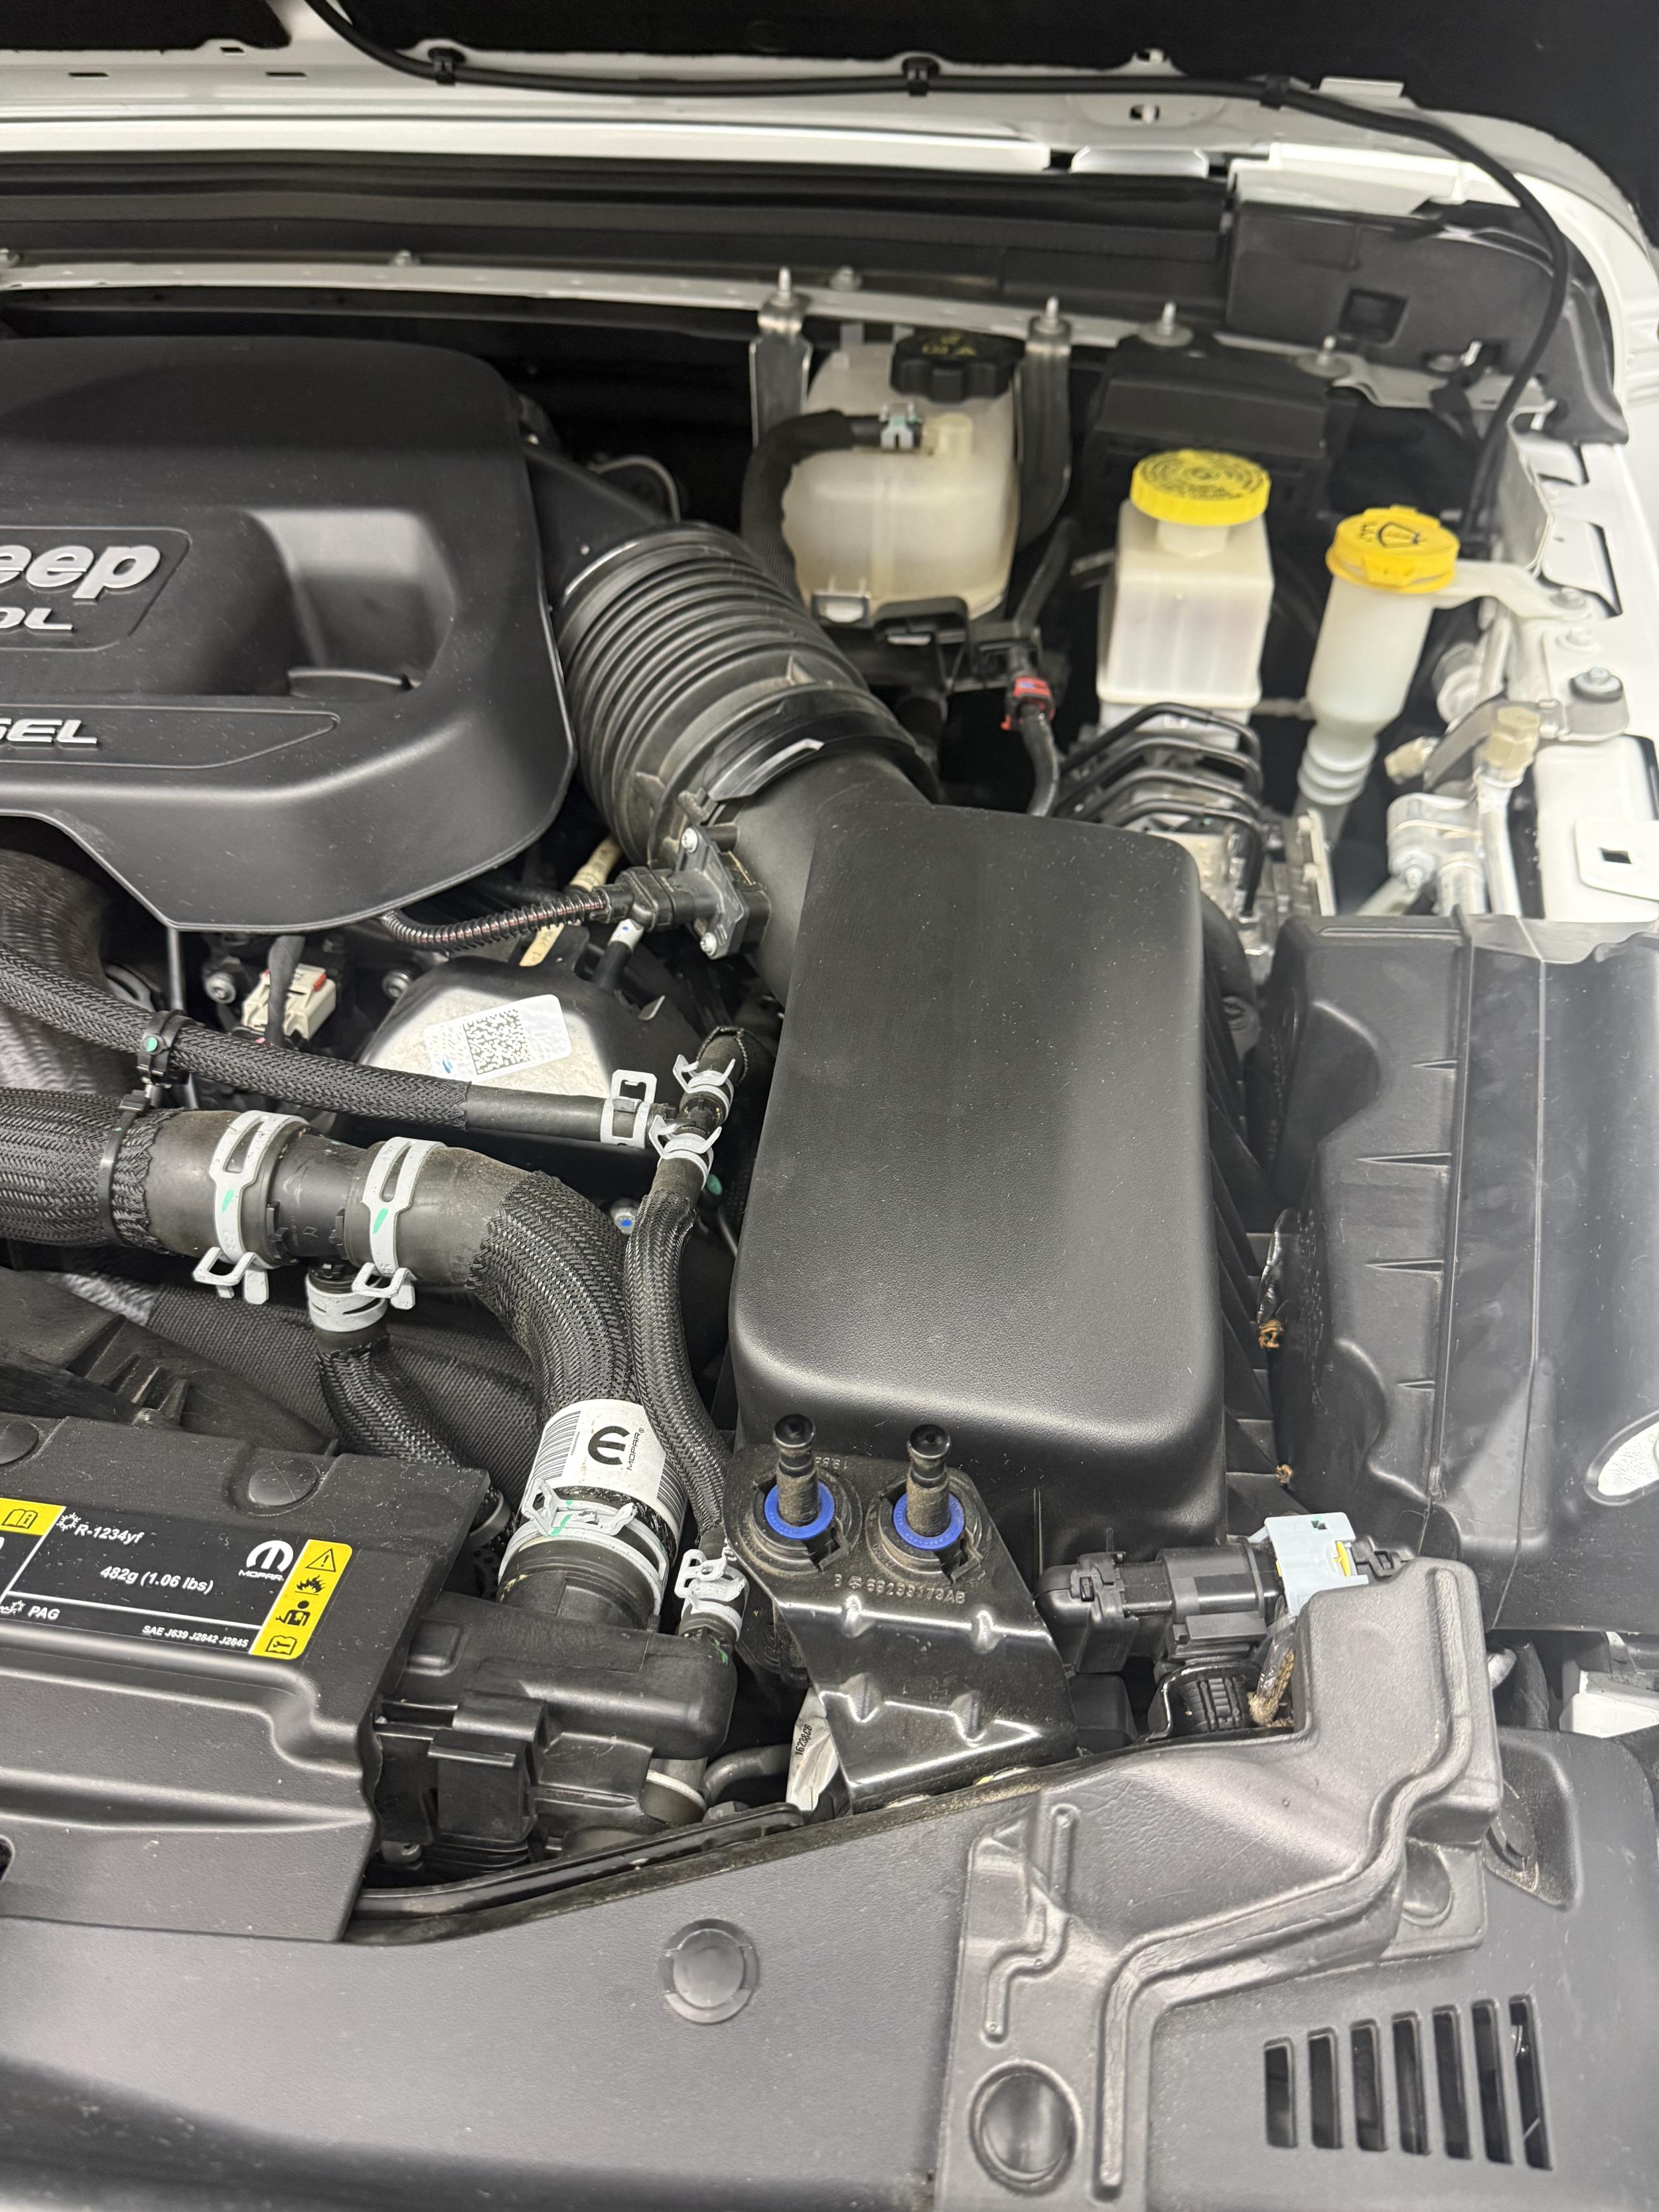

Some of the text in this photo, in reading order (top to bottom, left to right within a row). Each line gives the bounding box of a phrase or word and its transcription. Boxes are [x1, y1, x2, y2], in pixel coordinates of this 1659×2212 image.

[74, 1524, 145, 1545] R-1234yf
[100, 1566, 214, 1595] 482g (1.06 lbs)
[27, 1605, 60, 1620] PAG
[142, 1625, 249, 1649] SAE J639 J2842 J2845
[795, 1724, 812, 1755] 16238CB
